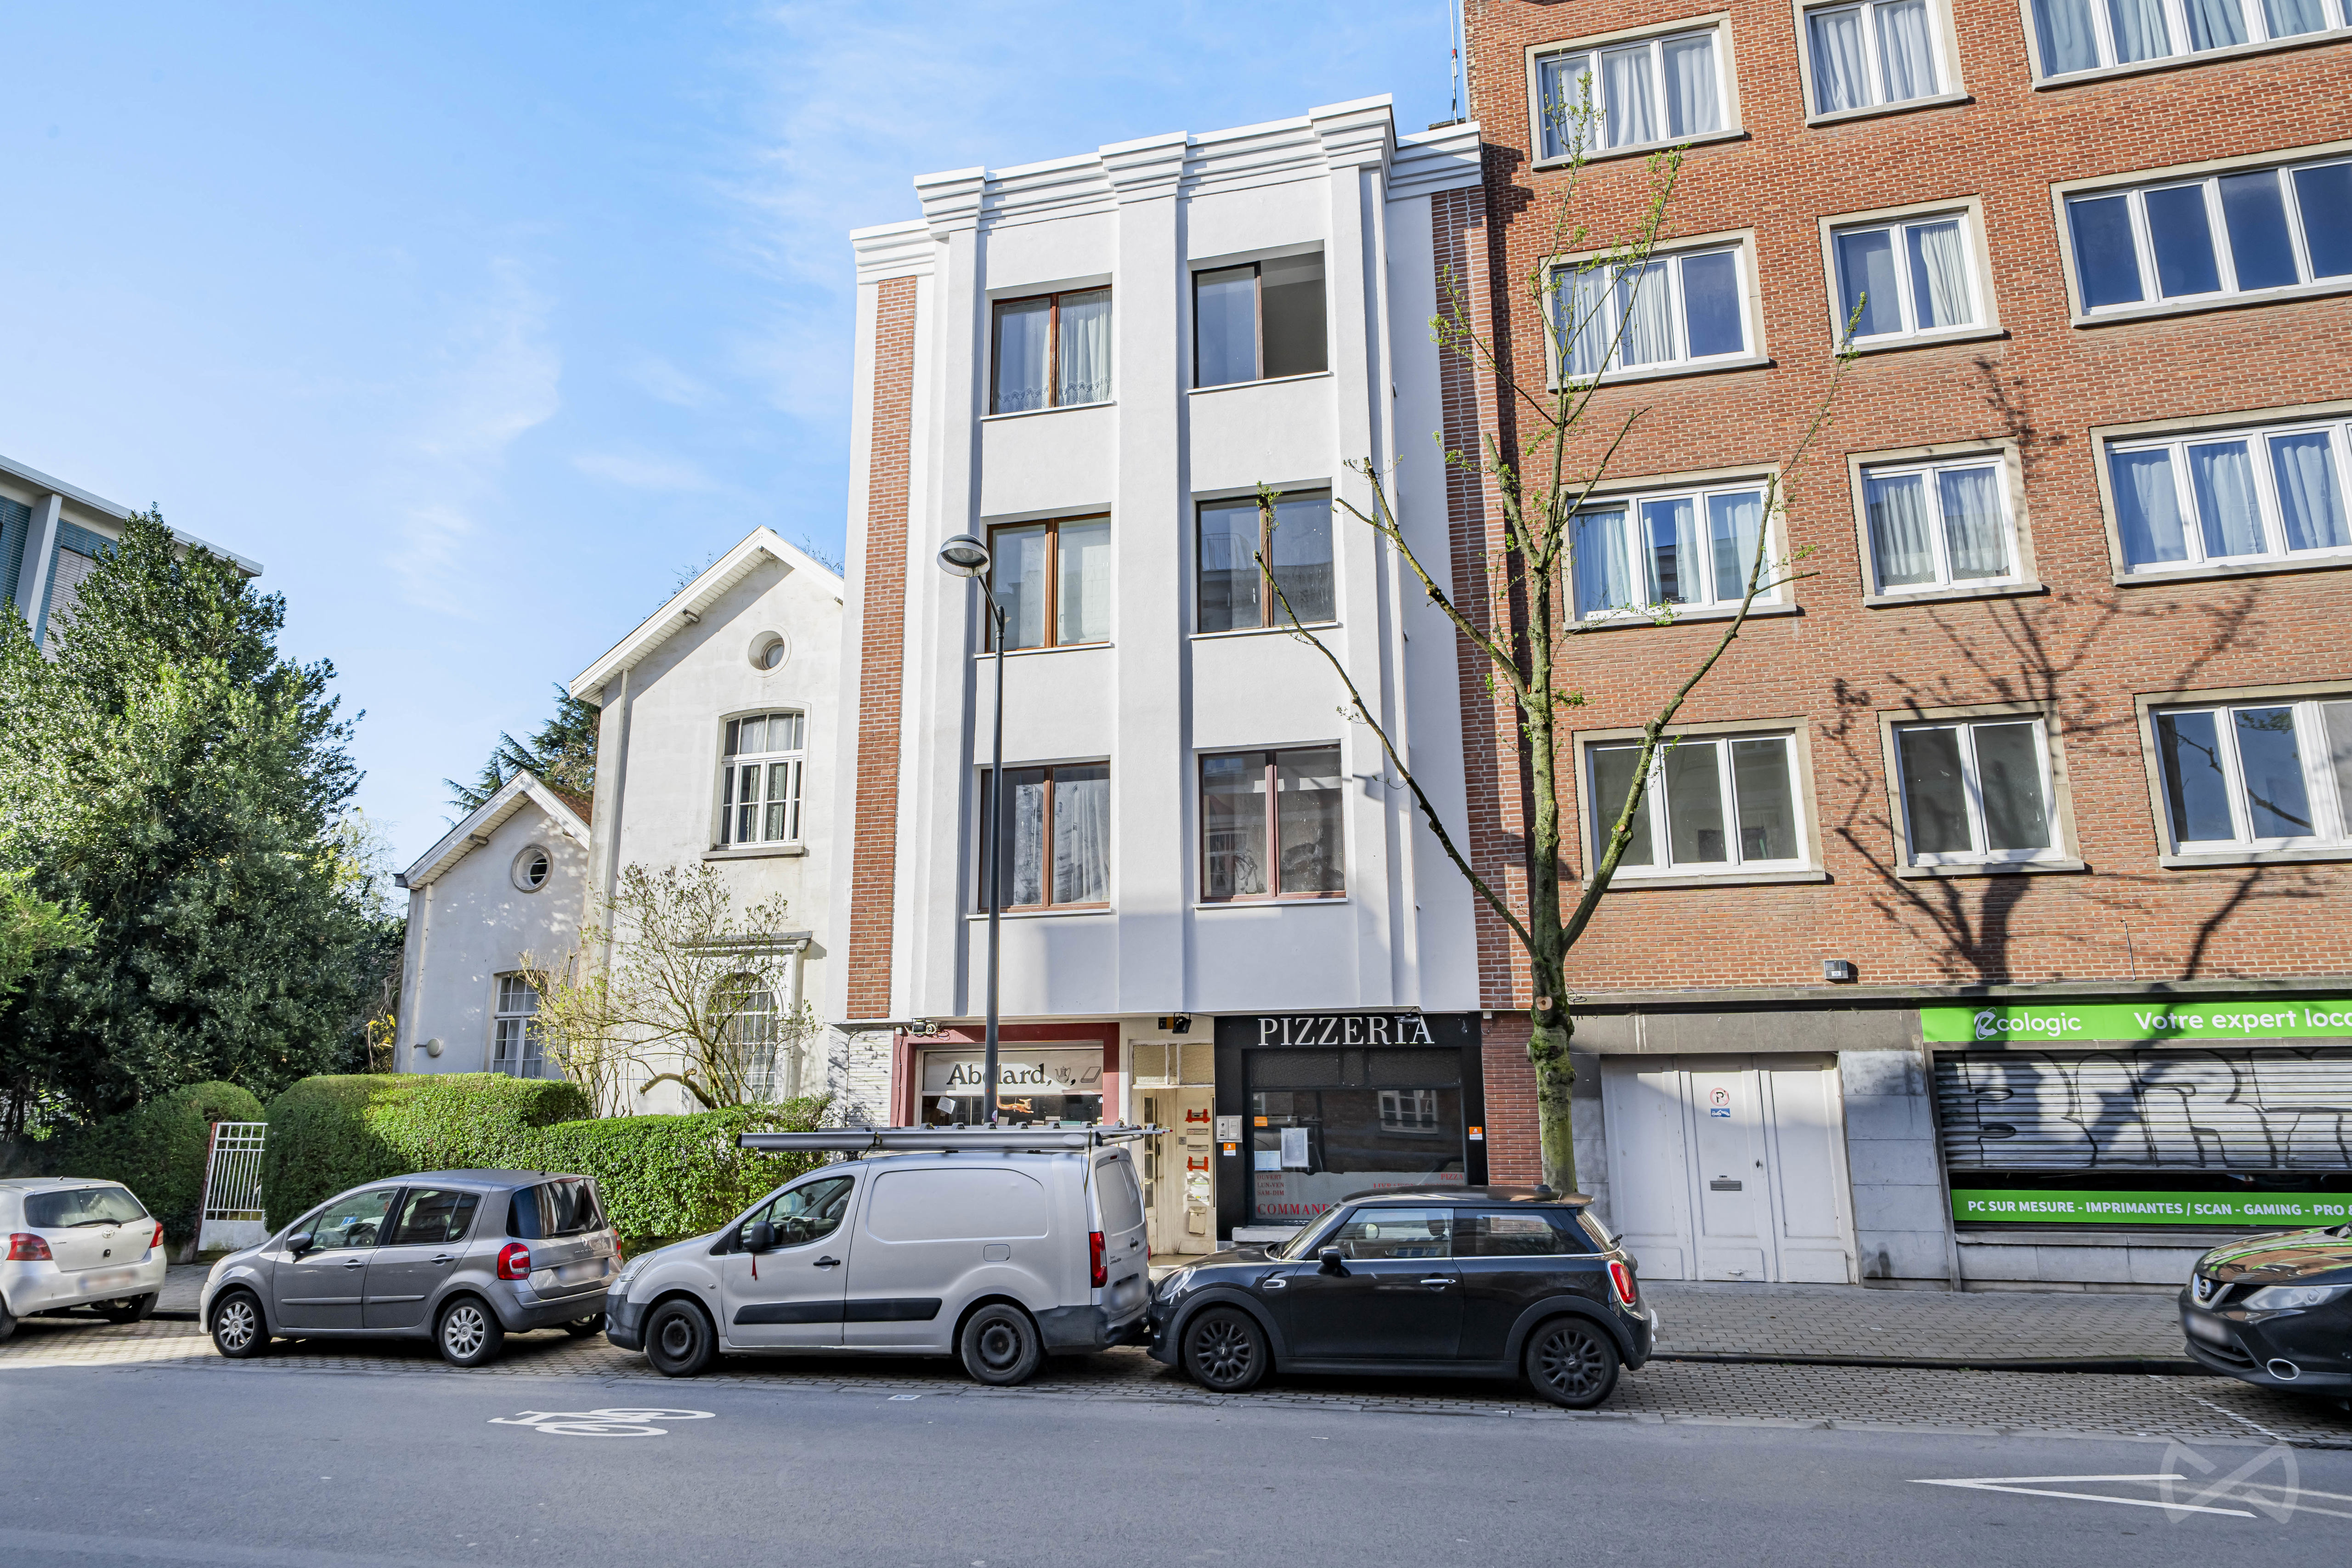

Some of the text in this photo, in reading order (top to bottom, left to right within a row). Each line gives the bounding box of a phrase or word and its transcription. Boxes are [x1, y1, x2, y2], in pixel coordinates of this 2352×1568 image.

[1258, 1015, 1435, 1045] PIZZERIA
[2134, 1012, 2203, 1030] Votre
[2212, 1011, 2296, 1033] expert
[946, 1063, 1052, 1086] Ablard,
[1716, 1092, 1724, 1103] P
[1968, 1201, 1986, 1211] PC
[1989, 1201, 2016, 1212] SUR
[2019, 1201, 2075, 1212] MESURE
[2086, 1202, 2183, 1214] IMPRIMANTES
[2187, 1203, 2190, 1216] /
[2194, 1204, 2232, 1215] SCAN
[2244, 1204, 2301, 1216] GAMING
[2313, 1205, 2344, 1216] PRO
